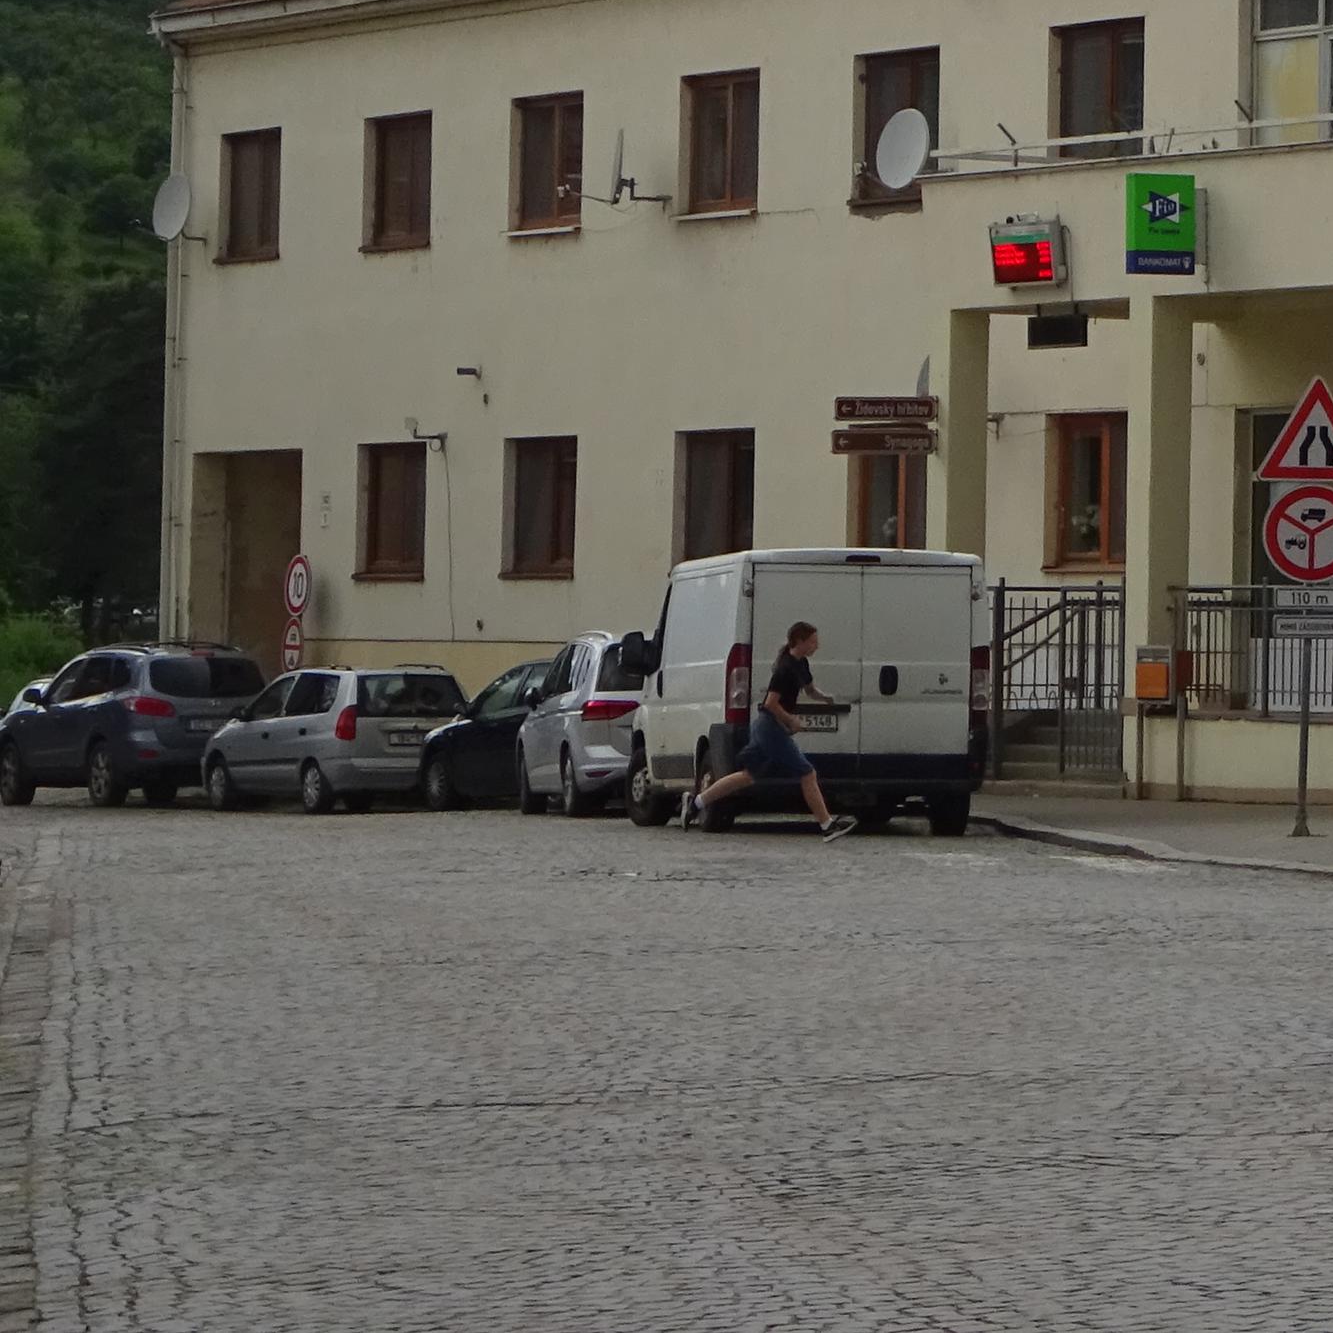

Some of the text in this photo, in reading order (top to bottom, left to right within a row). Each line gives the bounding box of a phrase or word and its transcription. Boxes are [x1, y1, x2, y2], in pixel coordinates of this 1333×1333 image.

[1154, 198, 1175, 218] Fio
[1138, 257, 1181, 266] BANKOMAT
[292, 571, 304, 599] 10
[1292, 592, 1328, 605] 110 m
